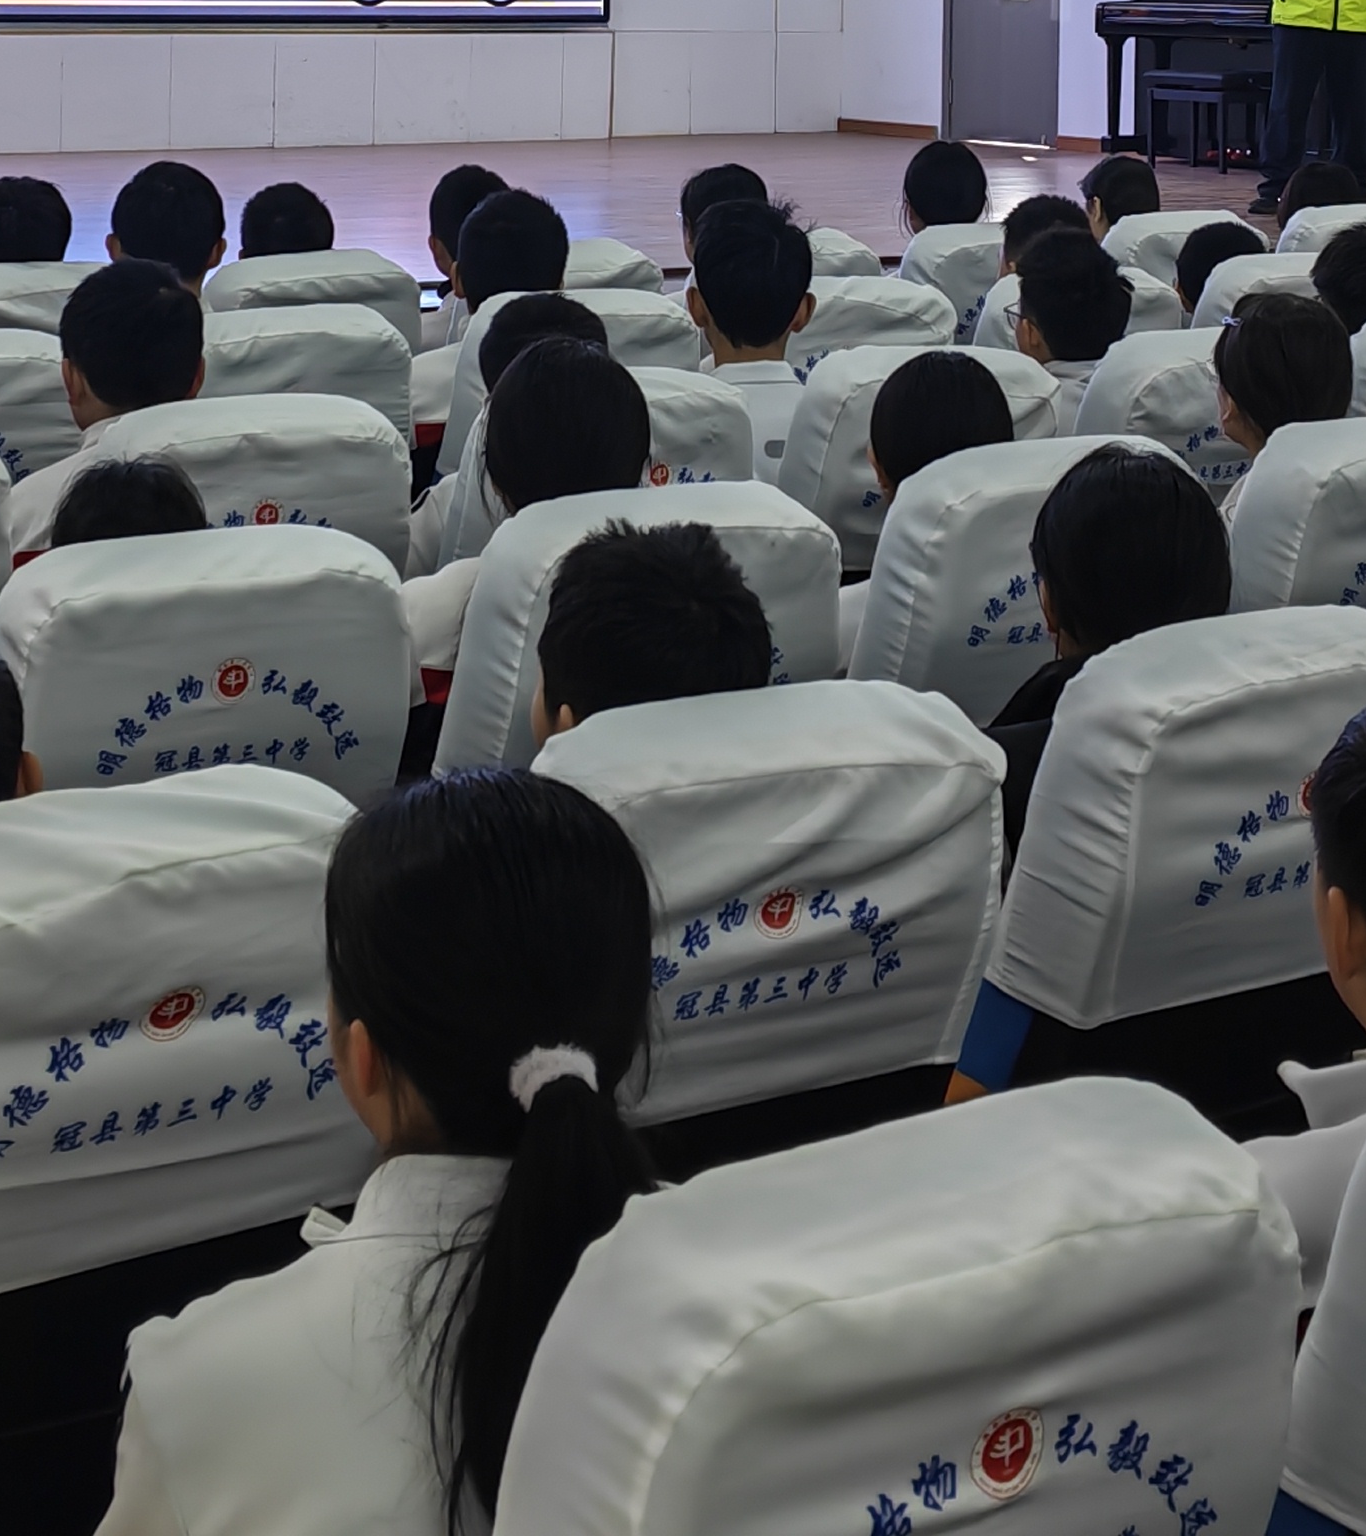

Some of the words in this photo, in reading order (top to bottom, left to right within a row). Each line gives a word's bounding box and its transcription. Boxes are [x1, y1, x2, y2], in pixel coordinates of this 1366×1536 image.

[96, 675, 203, 777] 明德格物
[261, 669, 360, 760] 弘毅致远
[154, 739, 311, 773] 冠县第三中学
[1194, 790, 1289, 906] 明德格物
[808, 888, 901, 988] 弘毅致远
[673, 962, 848, 1022] 冠县第三中学
[210, 993, 334, 1100] 弘毅致远
[50, 1077, 273, 1156] 冠县第三中学
